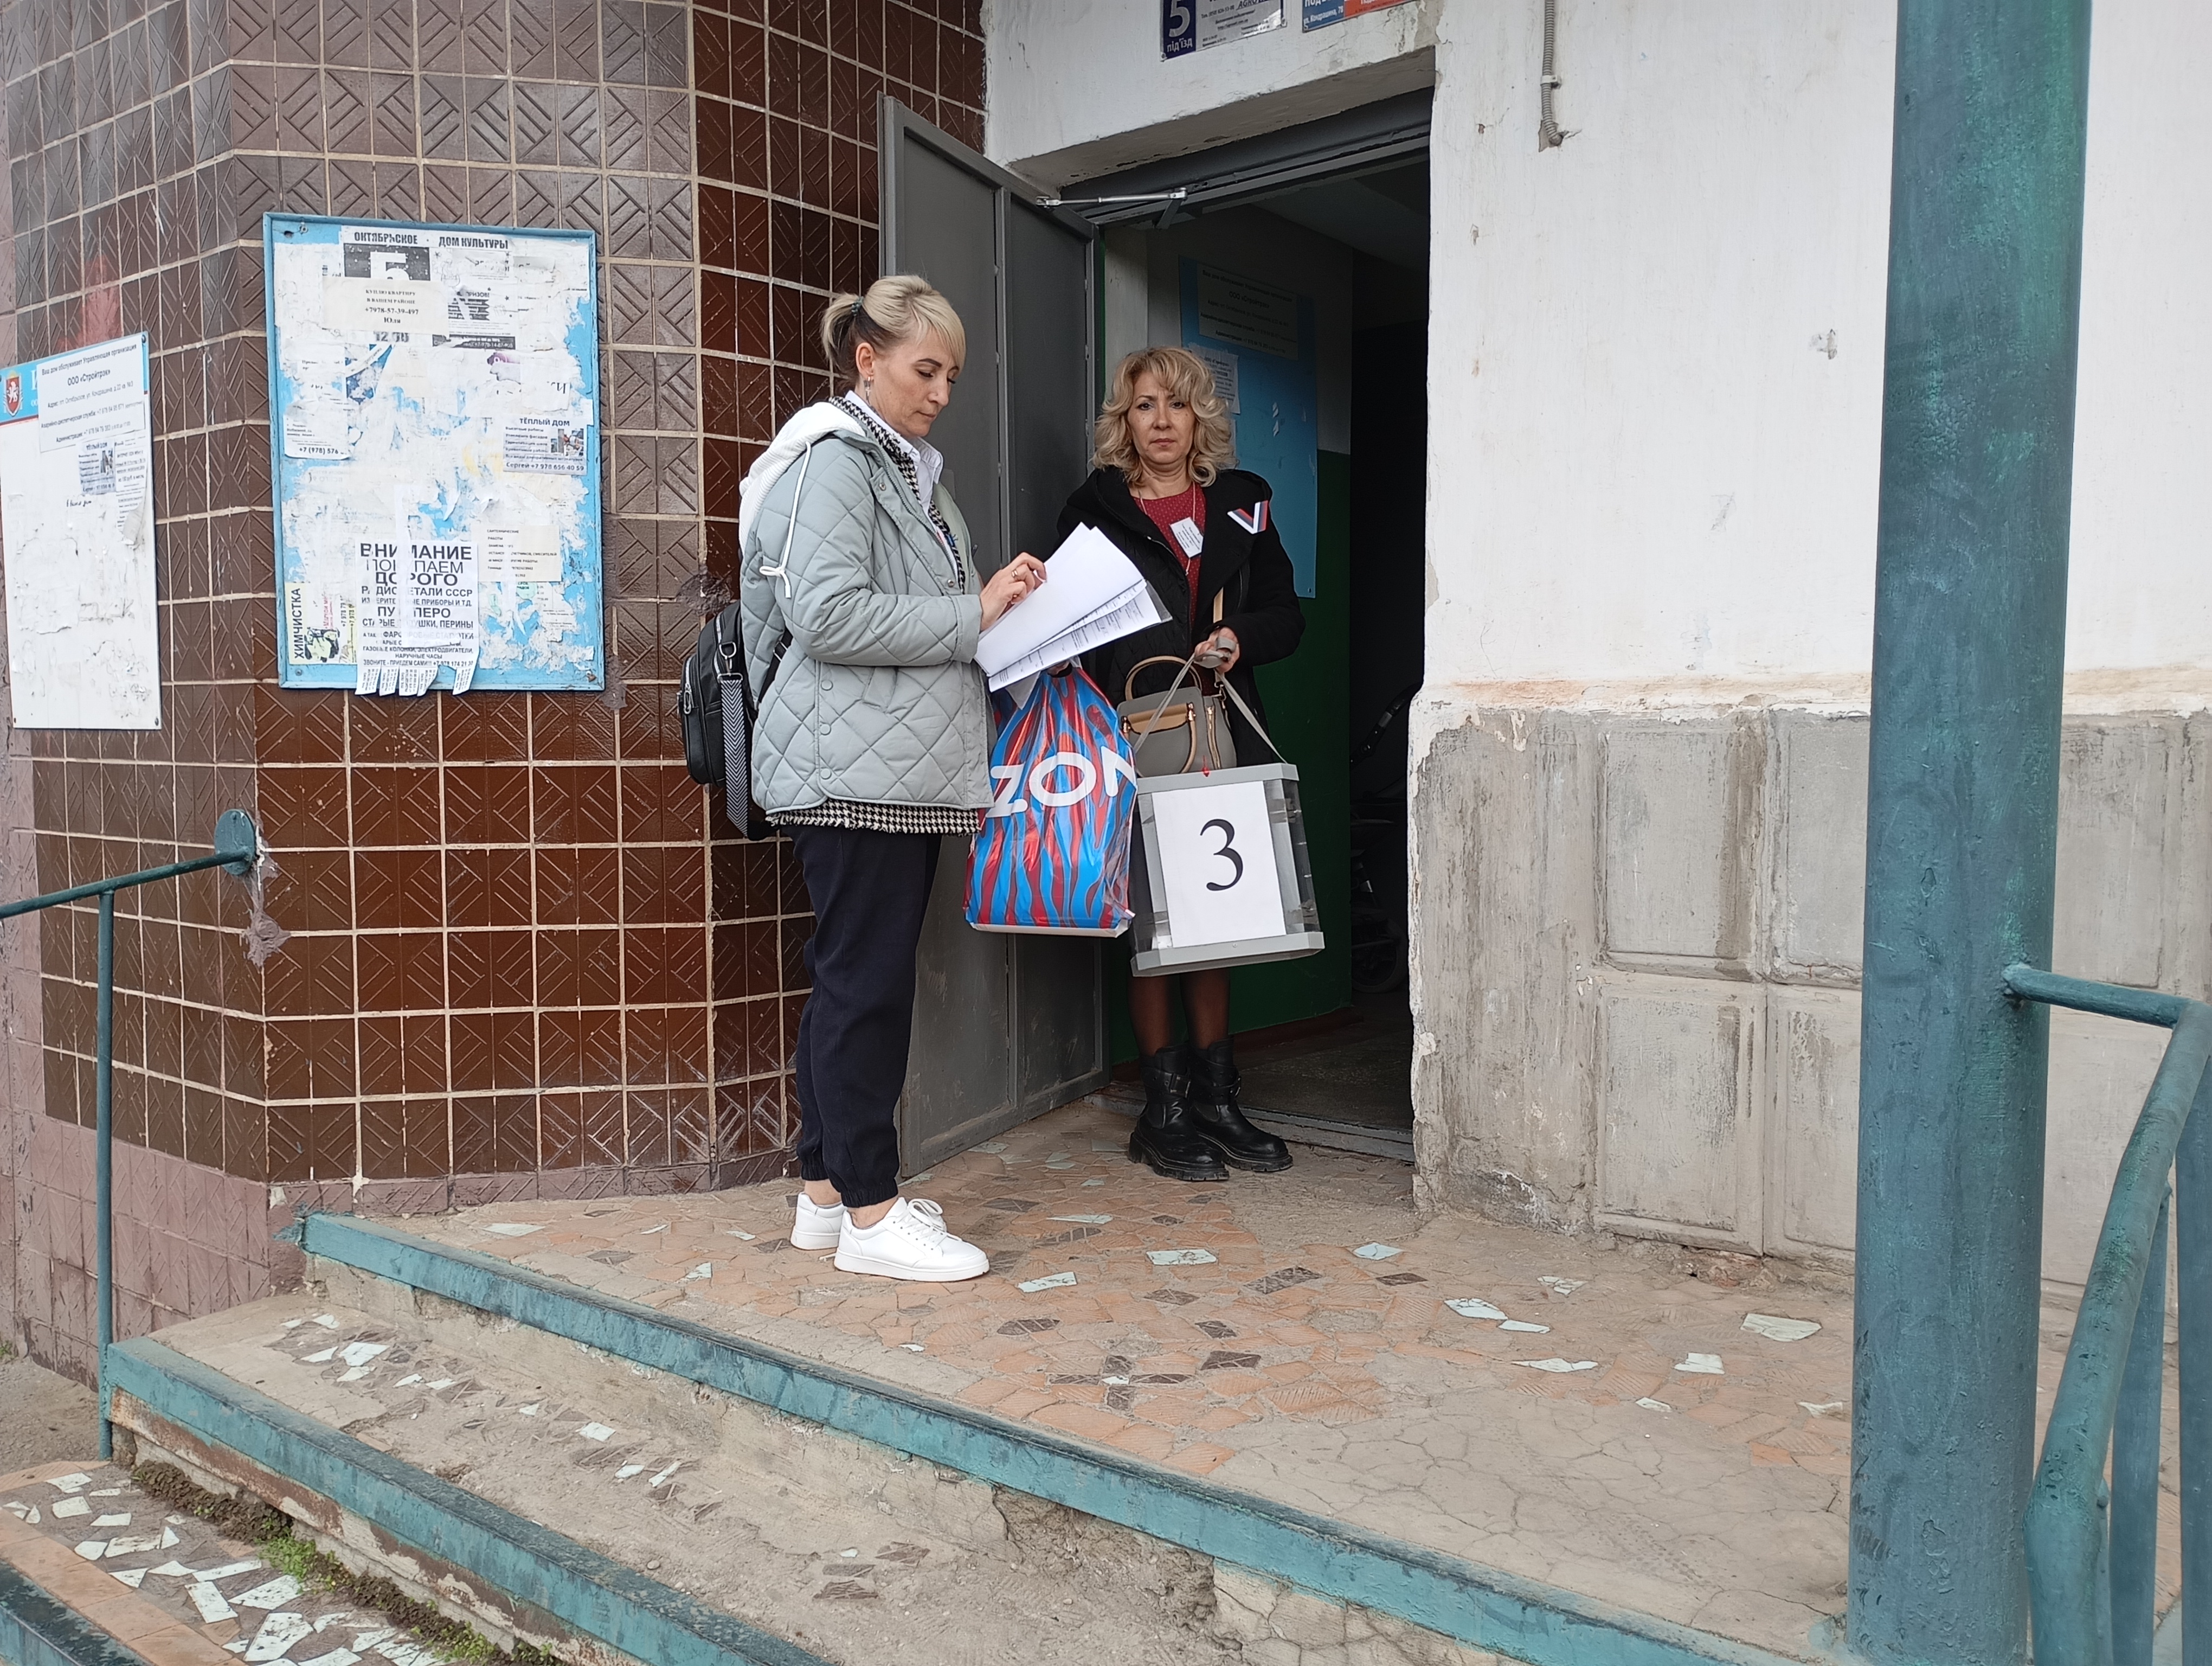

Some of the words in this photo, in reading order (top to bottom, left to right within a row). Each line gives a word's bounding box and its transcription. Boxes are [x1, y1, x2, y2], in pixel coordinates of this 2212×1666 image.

[1169, 0, 1190, 37] 5
[354, 232, 417, 245] ОКТЯБРЬСКОЕ
[439, 236, 459, 248] ДОМ
[462, 237, 508, 249] КУЛЬТУРЫ
[67, 376, 79, 386] ООО
[519, 418, 550, 426] ТЁПЛЫЙ
[308, 447, 325, 455] (978)
[366, 559, 463, 573] ПОПАЕМ
[446, 588, 473, 597] СССР
[414, 607, 451, 618] ПЕРО
[291, 588, 304, 659] ХИМЧИСТКА
[440, 620, 473, 629] ПЕРИНЫ
[986, 746, 1137, 817] ZON
[1200, 818, 1244, 892] 3
